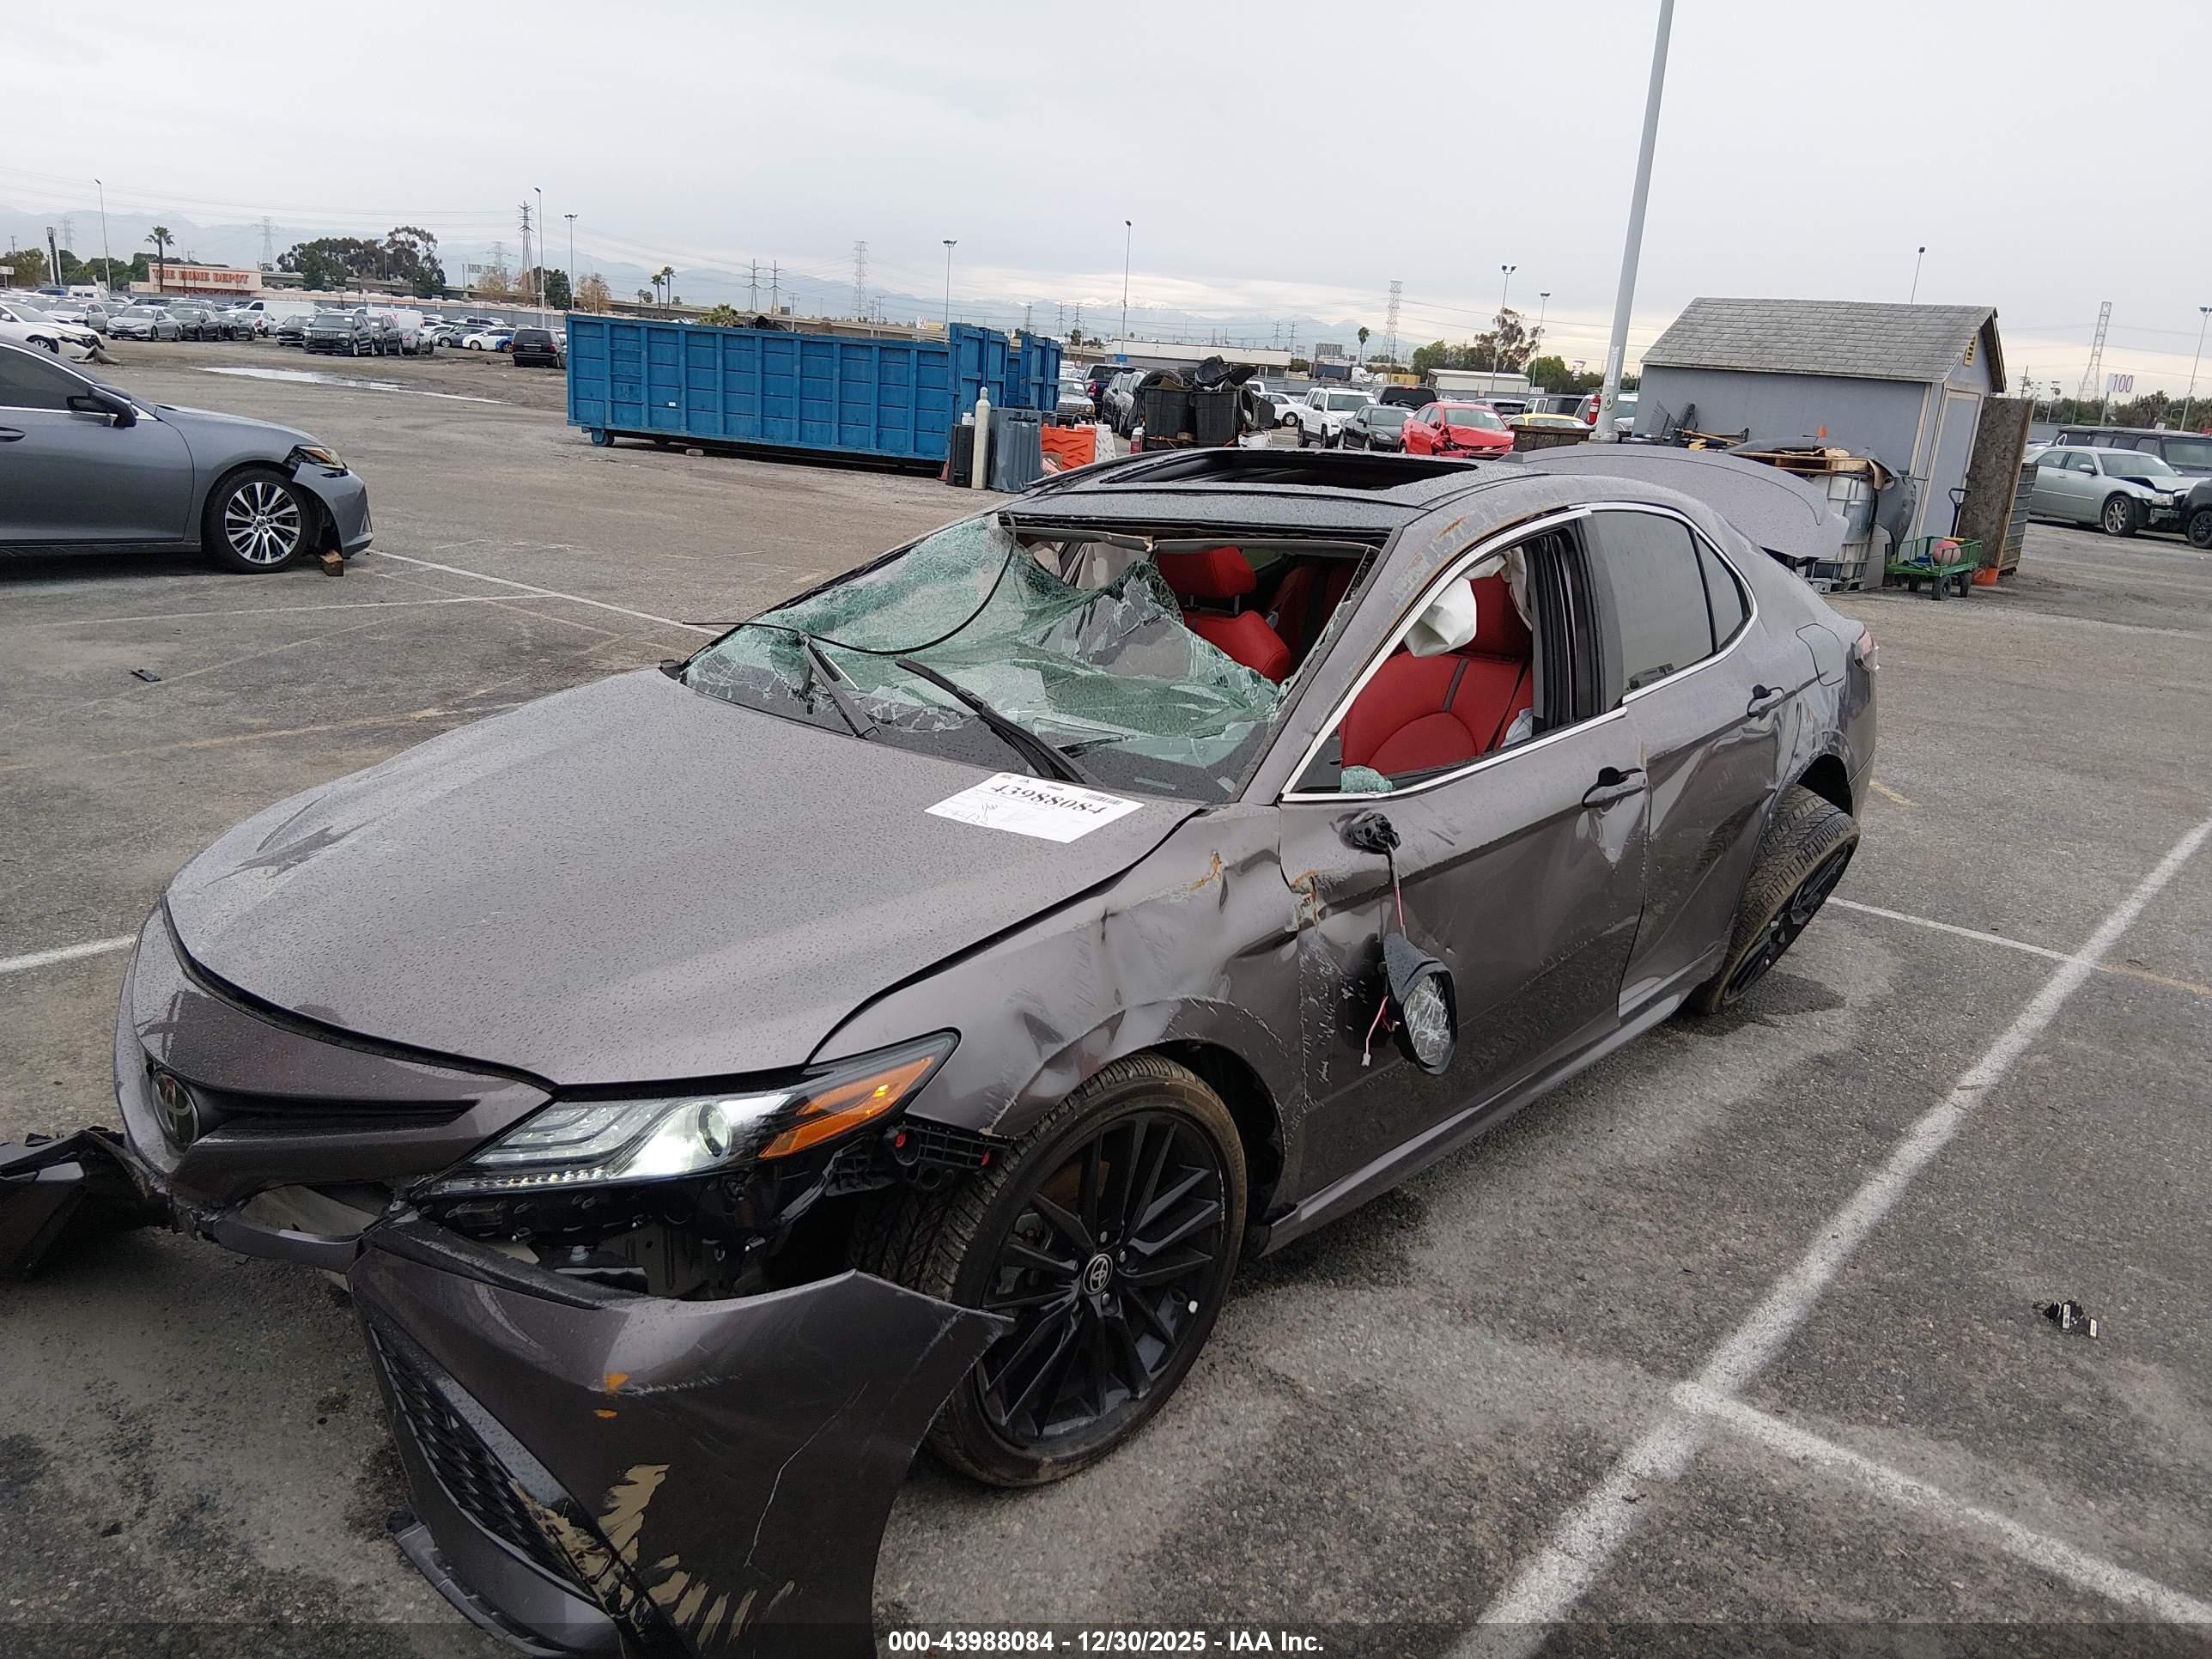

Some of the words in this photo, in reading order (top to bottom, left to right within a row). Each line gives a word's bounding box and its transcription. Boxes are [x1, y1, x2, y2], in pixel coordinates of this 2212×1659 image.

[179, 270, 210, 282] HOME
[213, 272, 249, 284] DEPOT
[2112, 374, 2134, 392] 100
[990, 784, 1107, 814] 43988084
